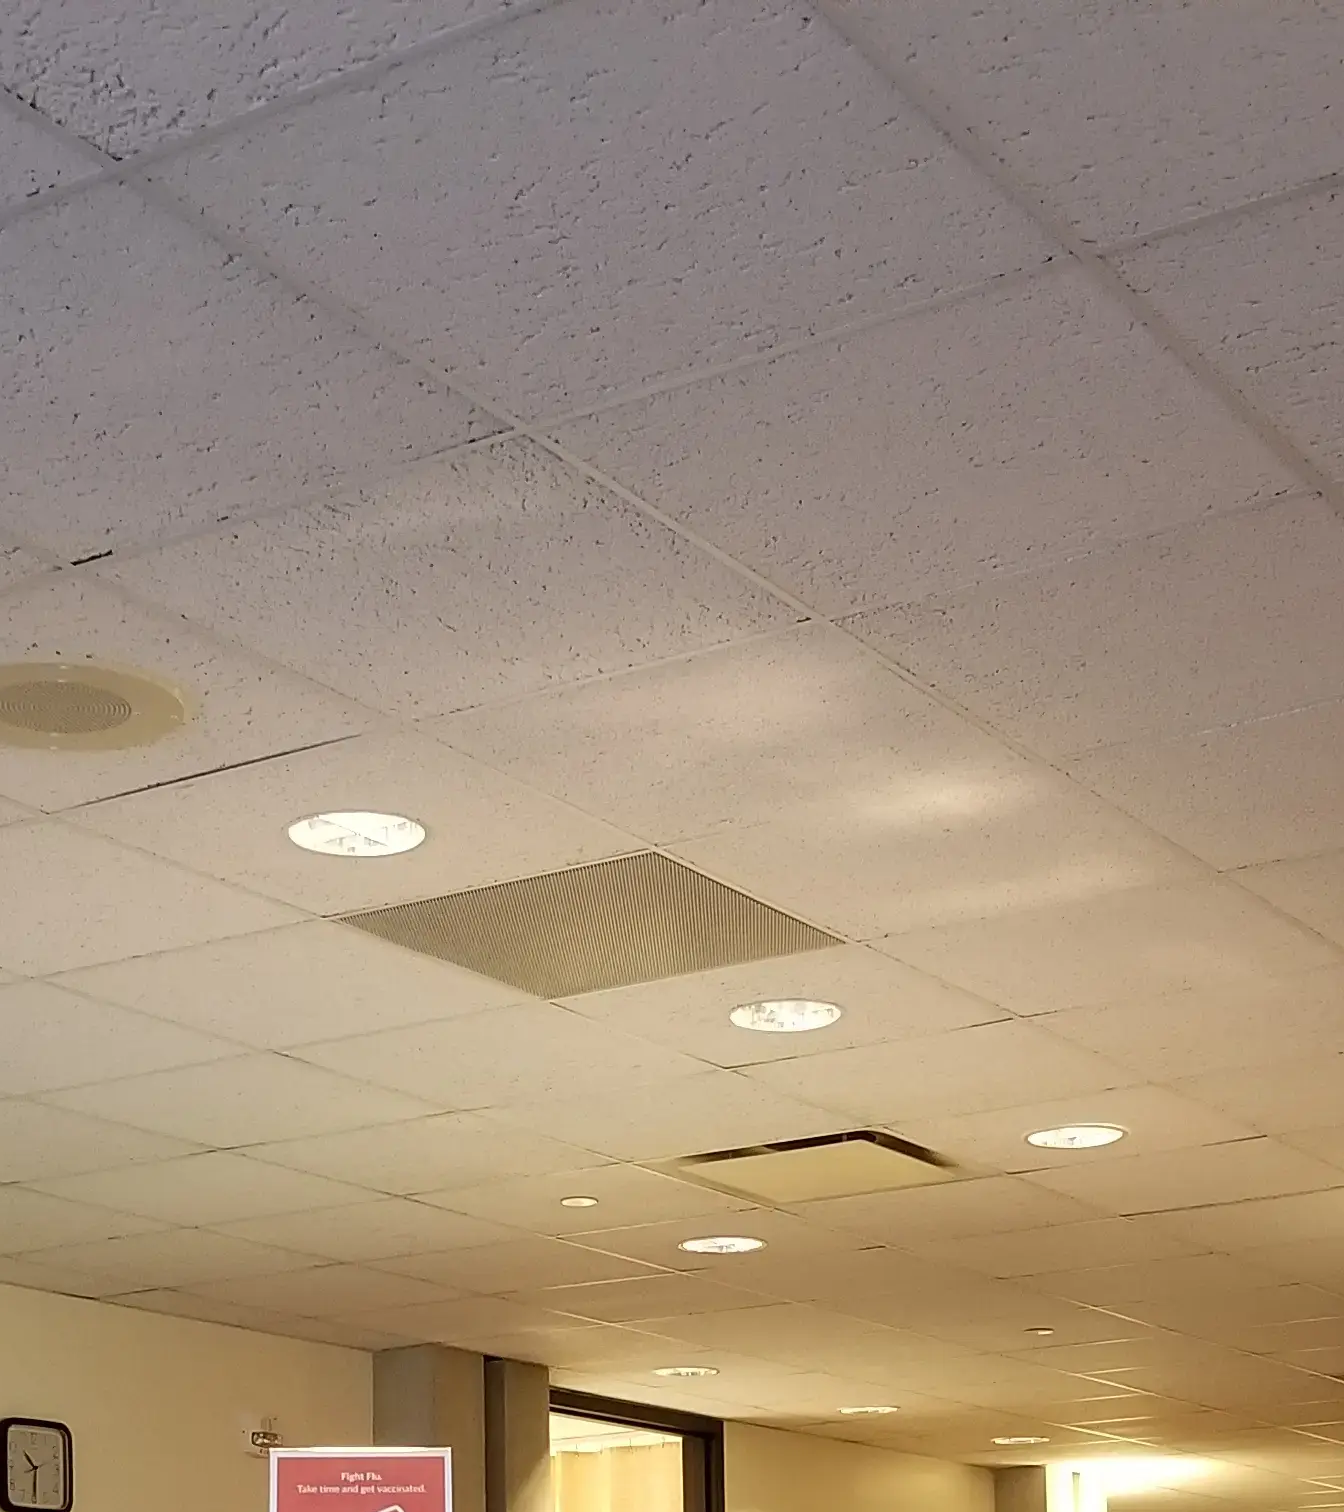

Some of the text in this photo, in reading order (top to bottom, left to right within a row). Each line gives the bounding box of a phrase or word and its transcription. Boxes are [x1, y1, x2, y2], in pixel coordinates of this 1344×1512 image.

[341, 1472, 364, 1482] Fight
[297, 1484, 427, 1495] Take time and get vaccinated.
